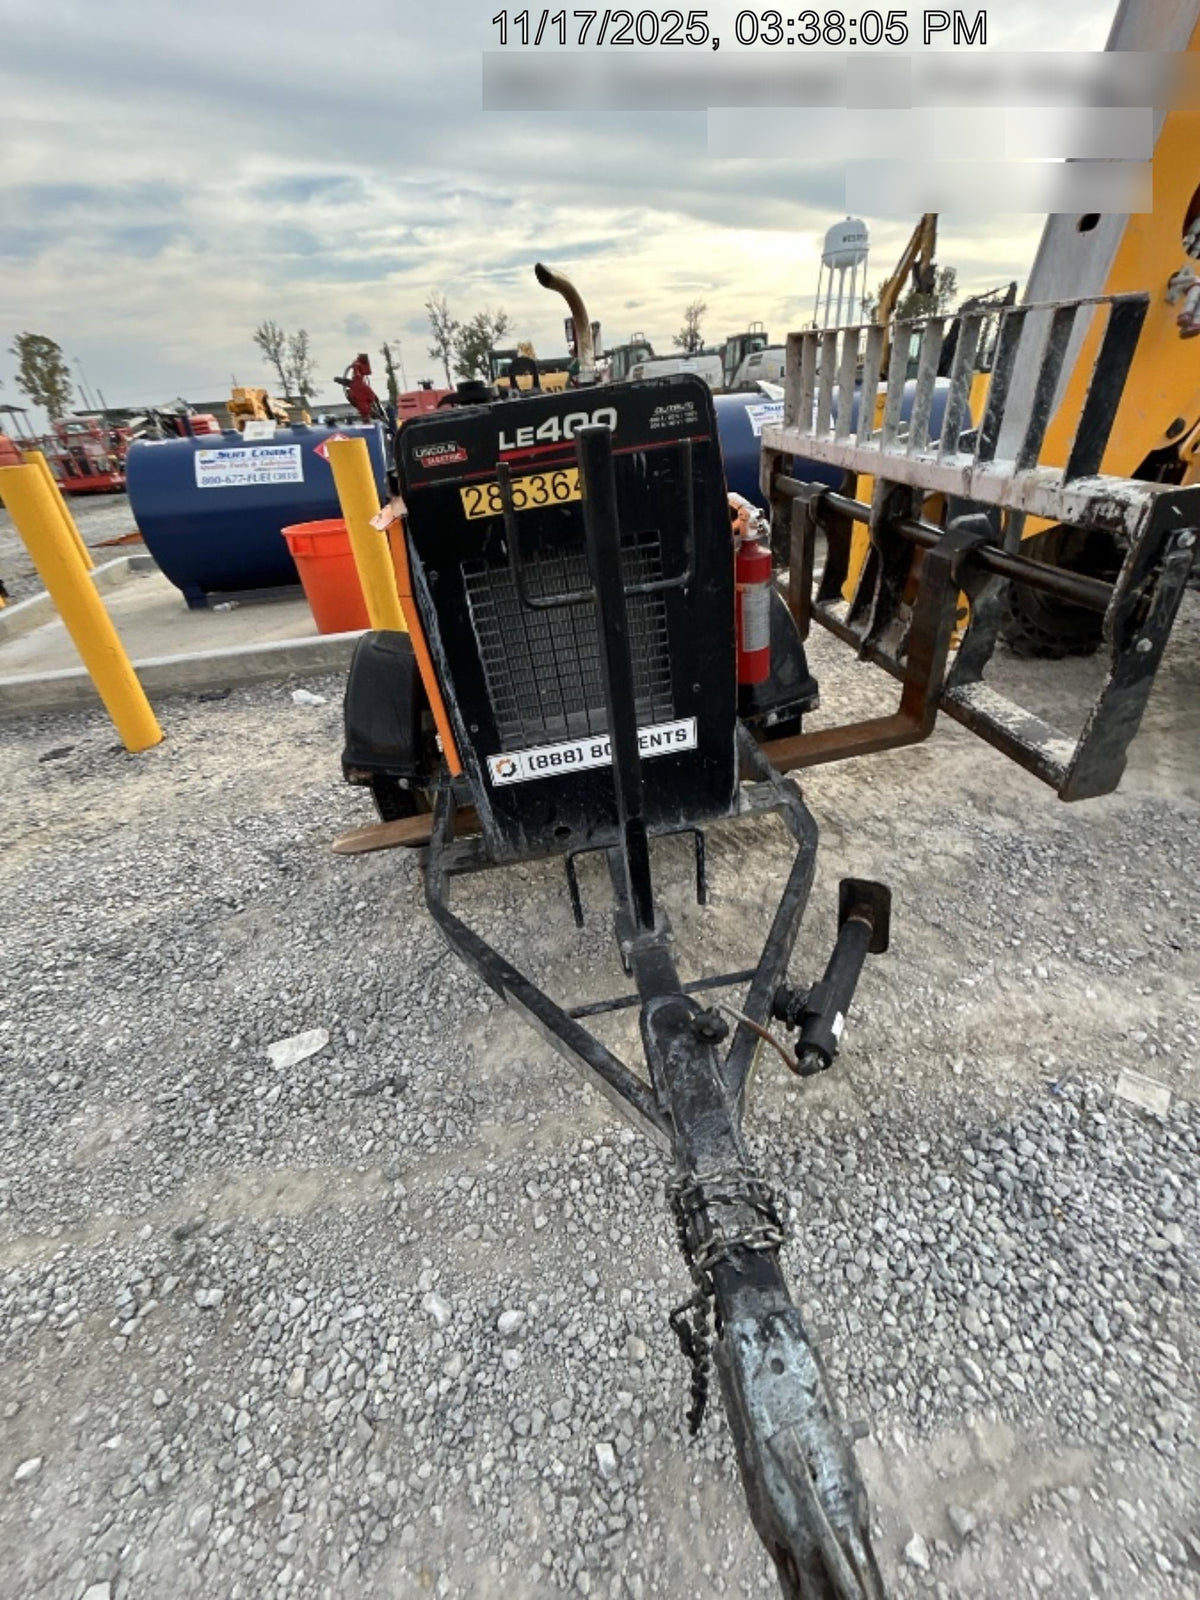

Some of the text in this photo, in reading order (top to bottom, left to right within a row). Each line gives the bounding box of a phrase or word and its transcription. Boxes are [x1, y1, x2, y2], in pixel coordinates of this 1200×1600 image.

[499, 406, 618, 450] LE400
[415, 443, 456, 458] LINCOLN
[528, 747, 584, 771] (888)
